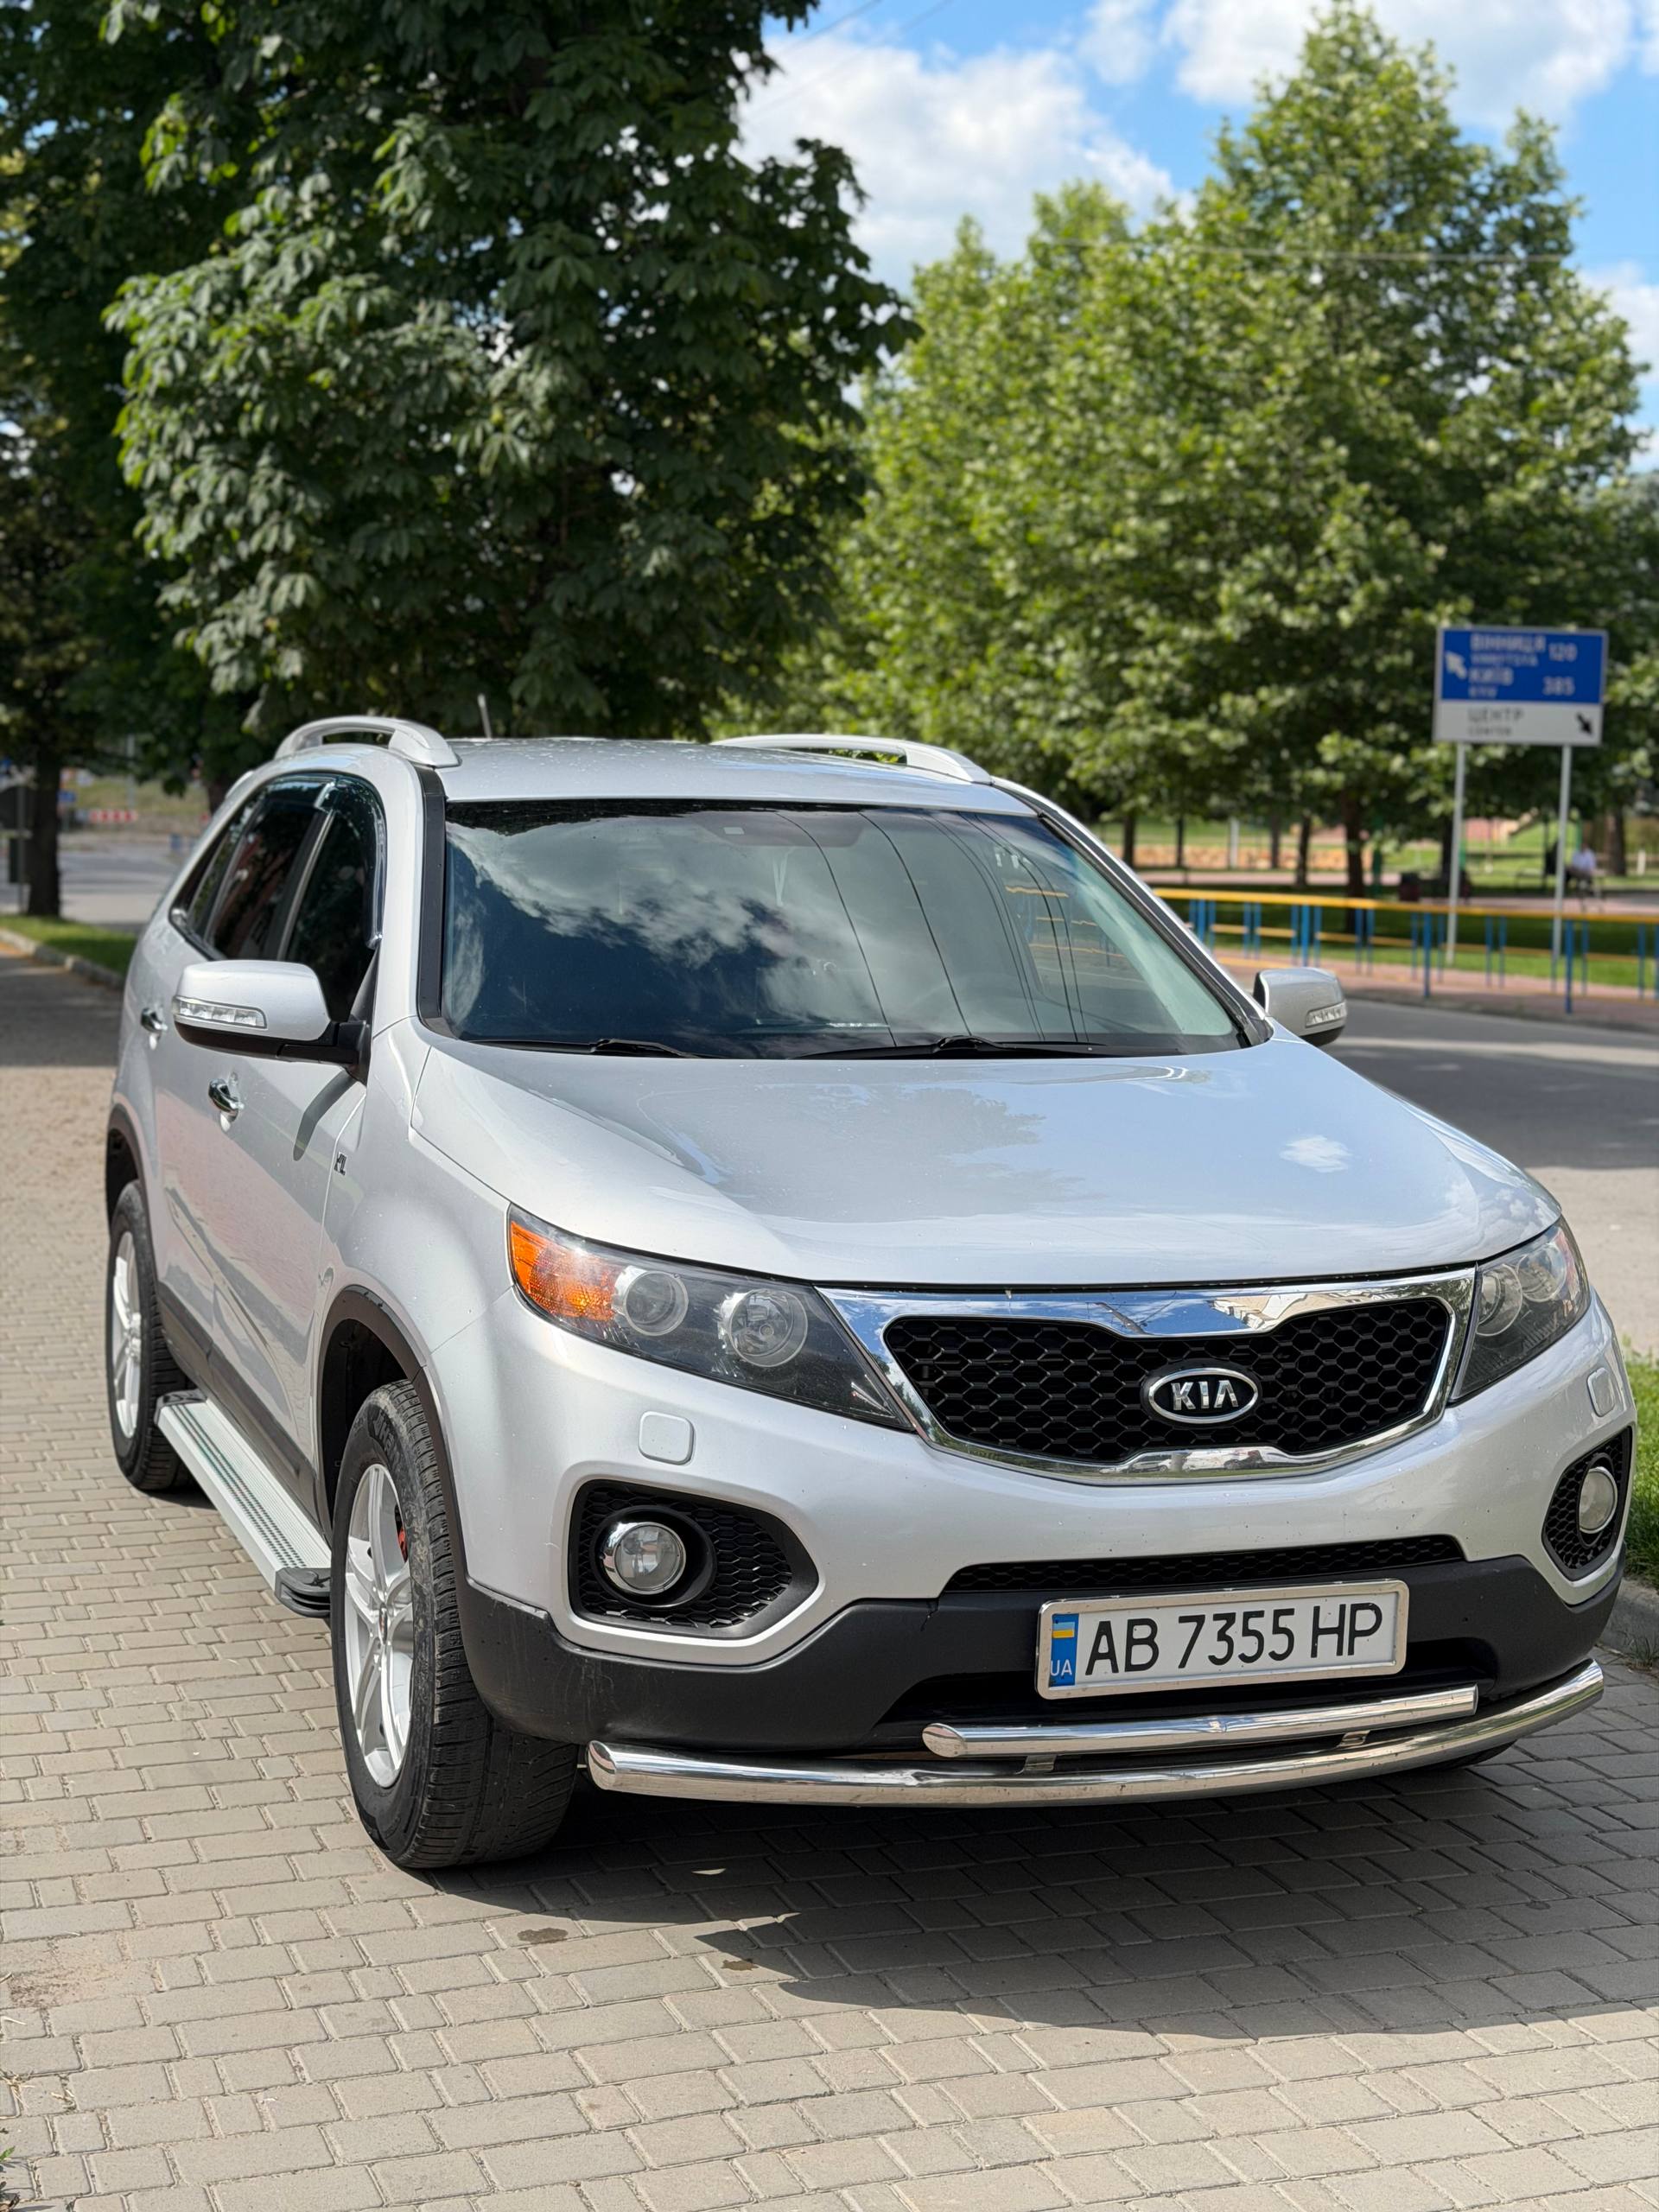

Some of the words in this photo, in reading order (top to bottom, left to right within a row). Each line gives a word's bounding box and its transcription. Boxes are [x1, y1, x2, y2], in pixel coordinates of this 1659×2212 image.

[1170, 1380, 1239, 1411] KIA
[1084, 1618, 1160, 1676] AB
[1178, 1607, 1296, 1669] 7355
[1310, 1602, 1383, 1659] HP
[1050, 1660, 1073, 1677] UA
